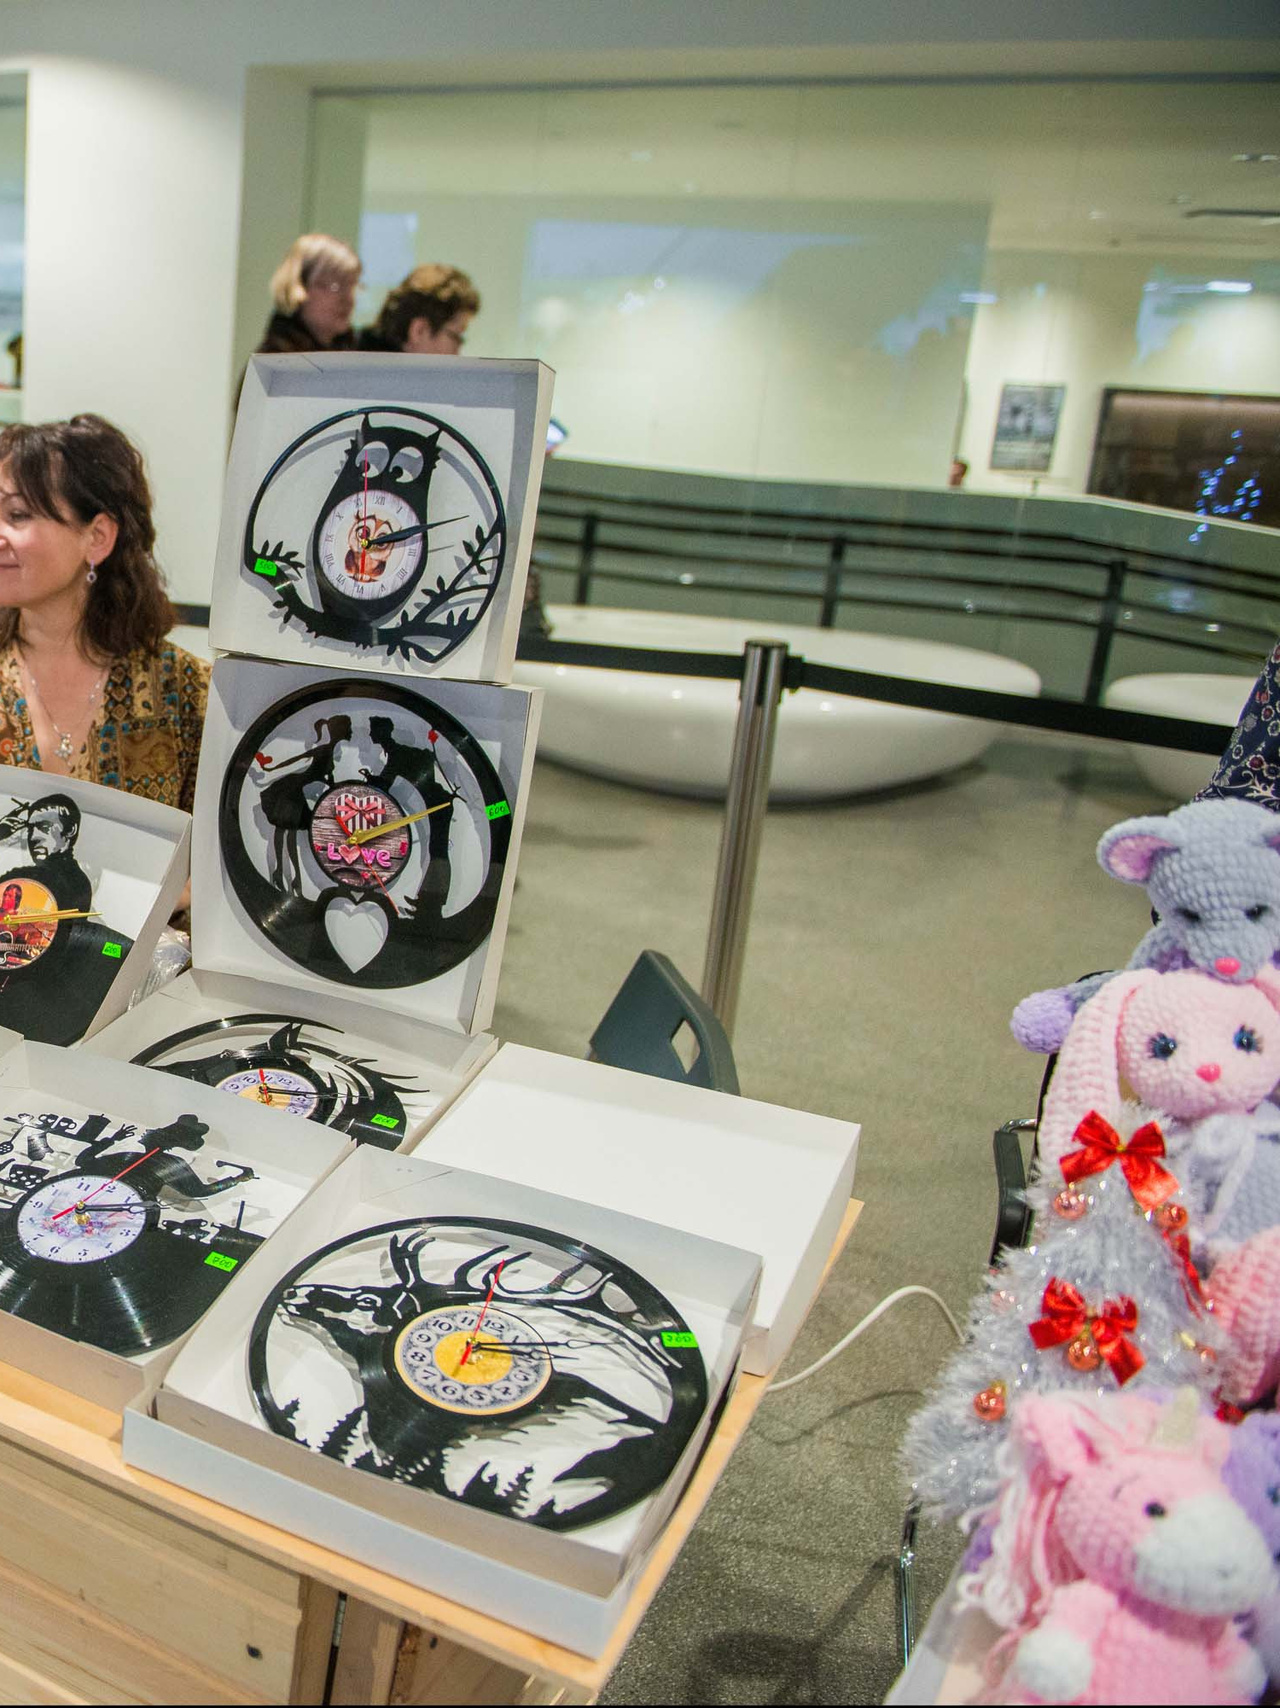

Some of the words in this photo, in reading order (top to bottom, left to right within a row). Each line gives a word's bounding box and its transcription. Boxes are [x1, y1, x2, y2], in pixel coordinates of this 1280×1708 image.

[489, 805, 506, 817] 600
[242, 1075, 257, 1084] 10
[76, 1182, 91, 1192] 11
[432, 1319, 453, 1332] 10
[460, 1315, 475, 1327] 11
[483, 1319, 505, 1333] 12
[416, 1333, 432, 1344] 9
[410, 1351, 427, 1362] 8
[421, 1369, 437, 1381] 7
[442, 1385, 458, 1396] 6
[470, 1389, 489, 1401] 5
